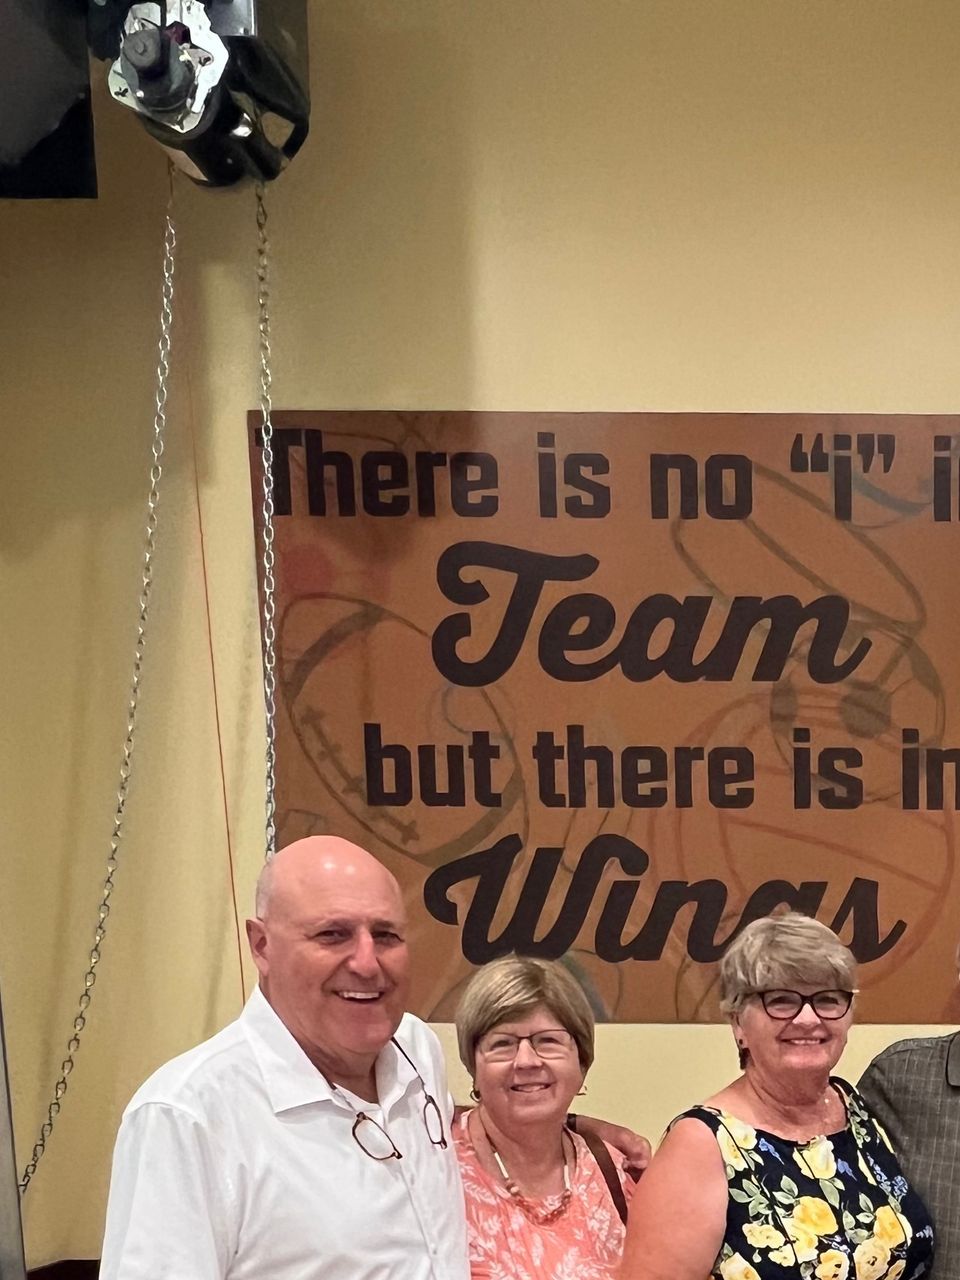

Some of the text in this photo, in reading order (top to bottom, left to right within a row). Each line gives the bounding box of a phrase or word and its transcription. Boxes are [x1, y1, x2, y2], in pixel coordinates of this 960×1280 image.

[255, 428, 499, 518] There
[537, 431, 611, 519] is
[650, 453, 753, 520] no
[431, 540, 873, 688] Team
[363, 722, 503, 808] but
[532, 724, 755, 809] there
[793, 727, 864, 810] is
